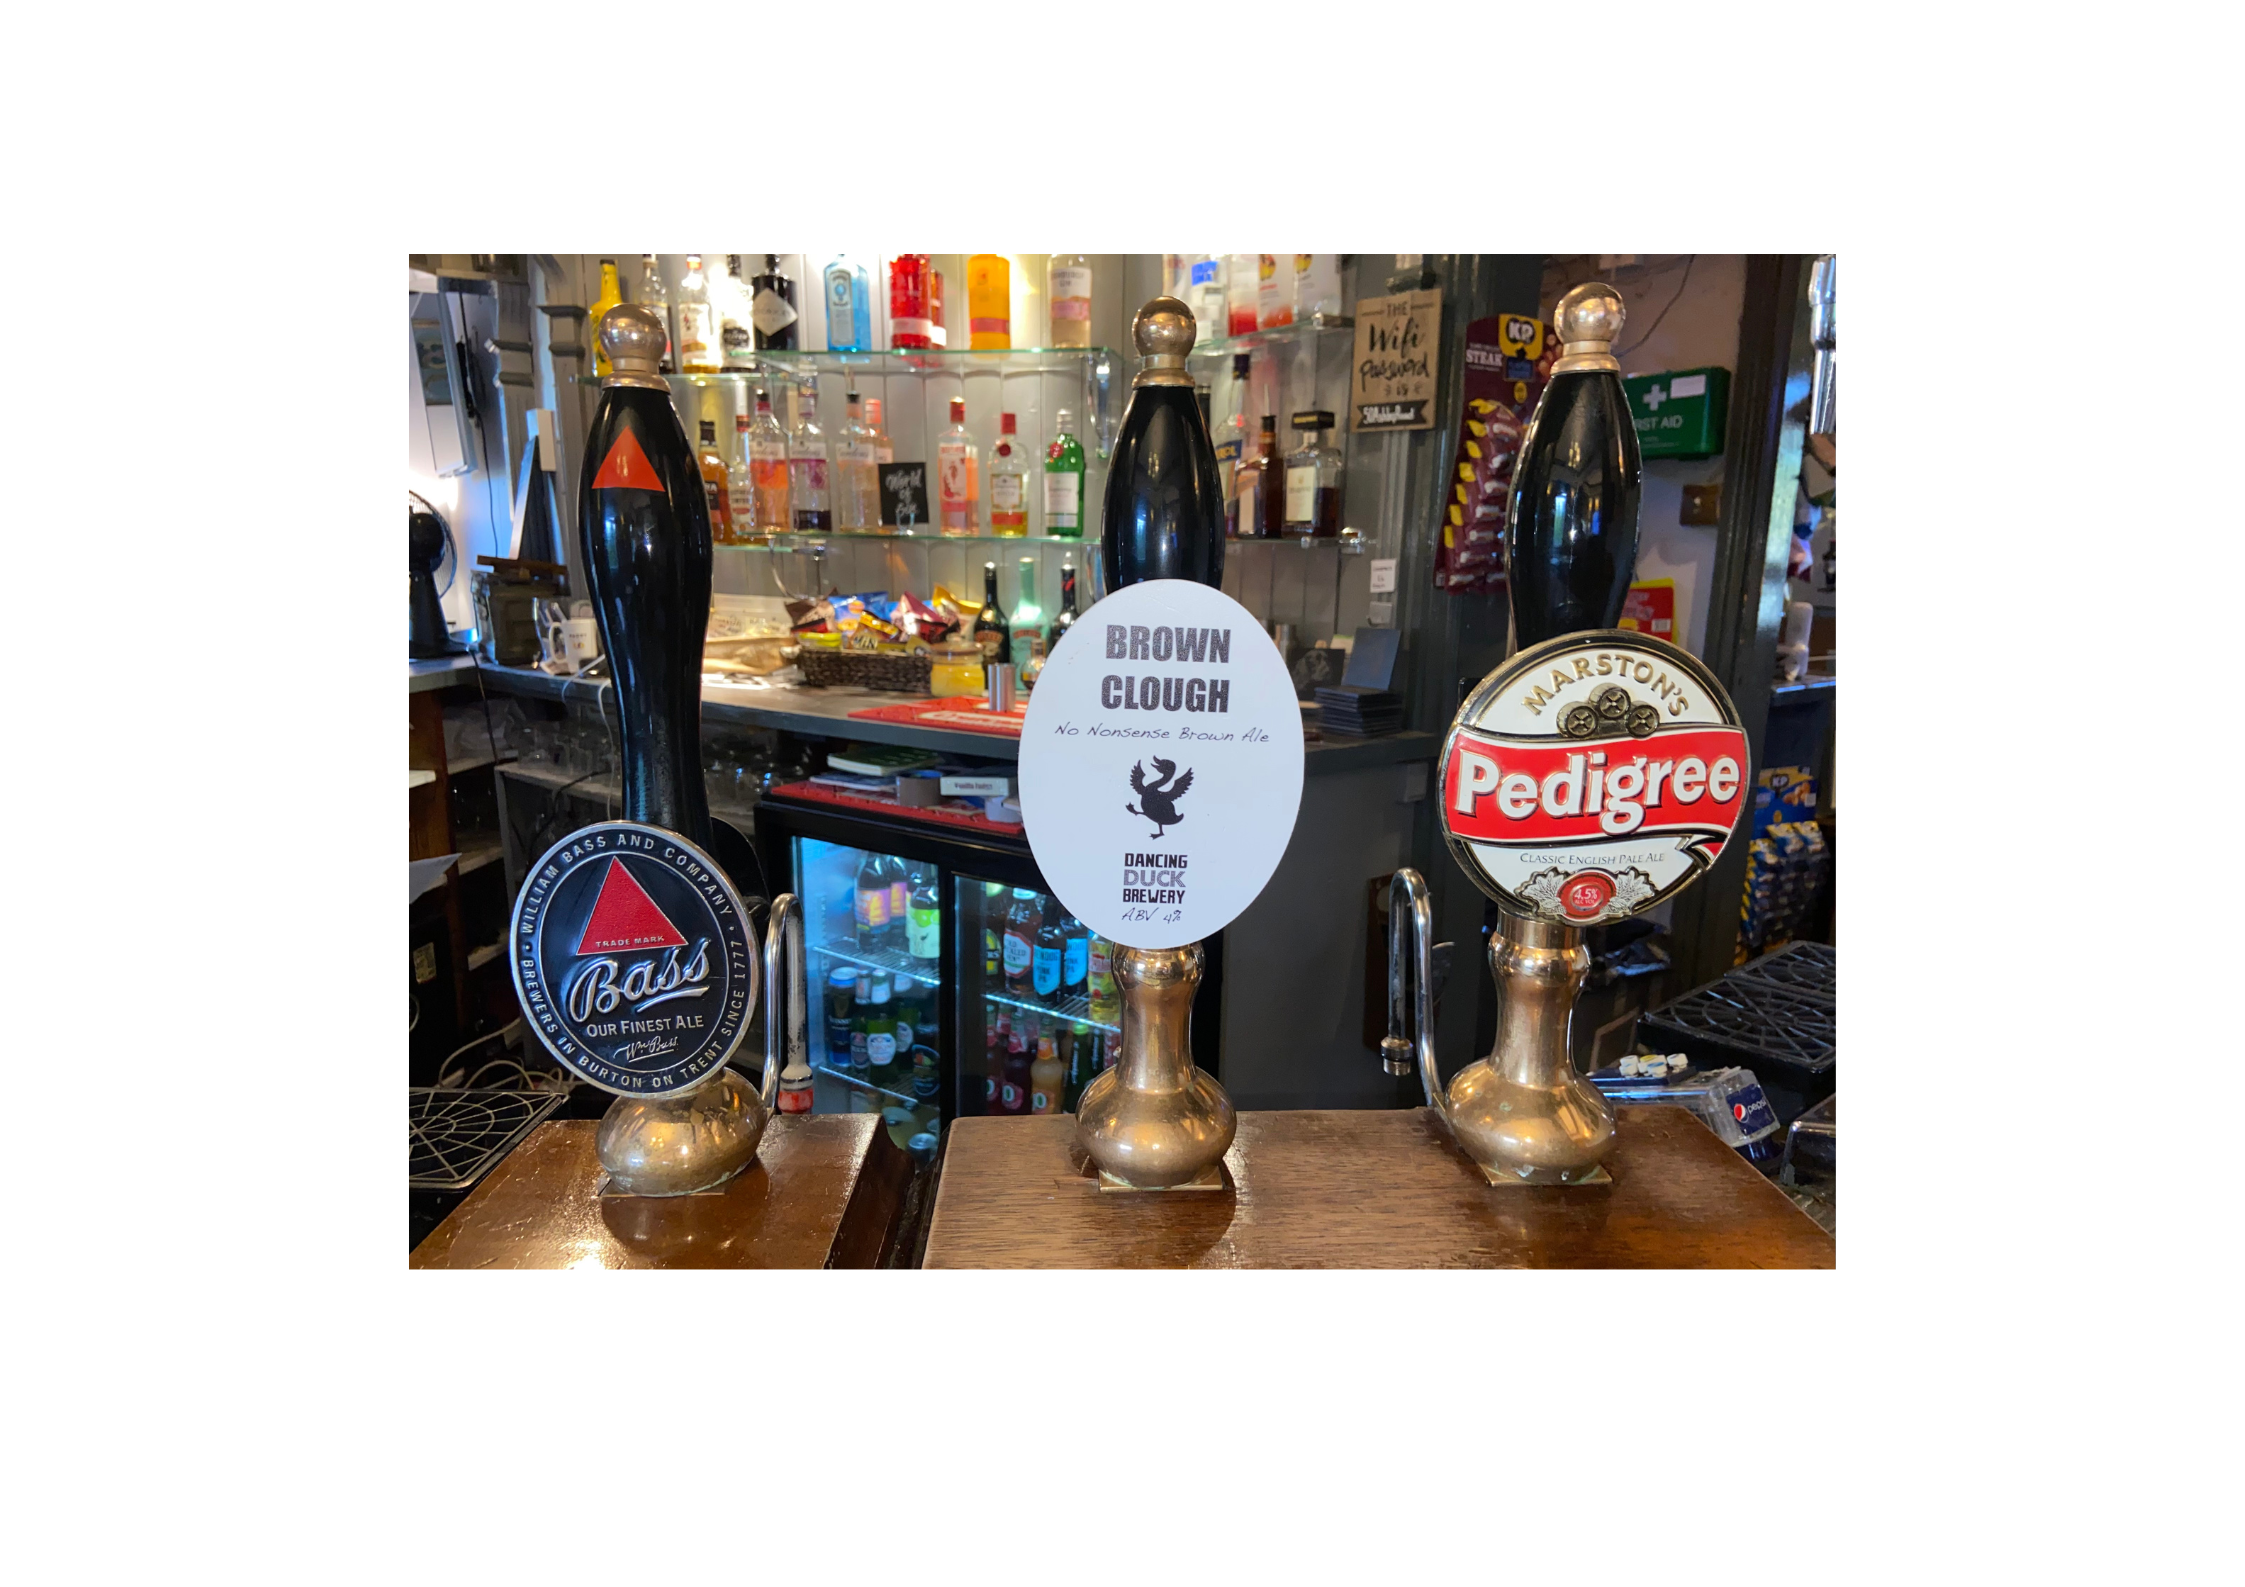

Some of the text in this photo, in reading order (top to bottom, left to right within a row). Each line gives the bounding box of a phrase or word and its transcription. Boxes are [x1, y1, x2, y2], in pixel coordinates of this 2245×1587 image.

[1386, 302, 1409, 317] THE
[1369, 317, 1427, 359] Wifi
[1508, 320, 1534, 343] KP
[1466, 349, 1503, 367] STEAK
[1634, 415, 1683, 432] RST AID
[1106, 624, 1231, 664] BROWN
[1101, 675, 1231, 713] CLOUGH
[1521, 653, 1690, 717] MARSTON'S
[1055, 721, 1270, 743] No Nonsense Brown Ale
[1454, 749, 1741, 836] Pedigree
[1124, 853, 1188, 869] DANCING
[1520, 851, 1665, 865] CLASSIC ENGLISH PALE ALE
[522, 834, 733, 934] WILLIAM BASS AND COMPANY
[1123, 869, 1187, 888] DUCK
[1122, 888, 1186, 905] BREWERY
[1574, 888, 1598, 900] 4.5%
[1122, 907, 1160, 922] ABV
[595, 935, 665, 948] TRADE MARK
[570, 937, 713, 1023] Bass
[522, 941, 746, 1089] BREWERS IN BURTON ON TRENT SINCE 1777
[586, 1015, 705, 1038] OUR FINEST ALE
